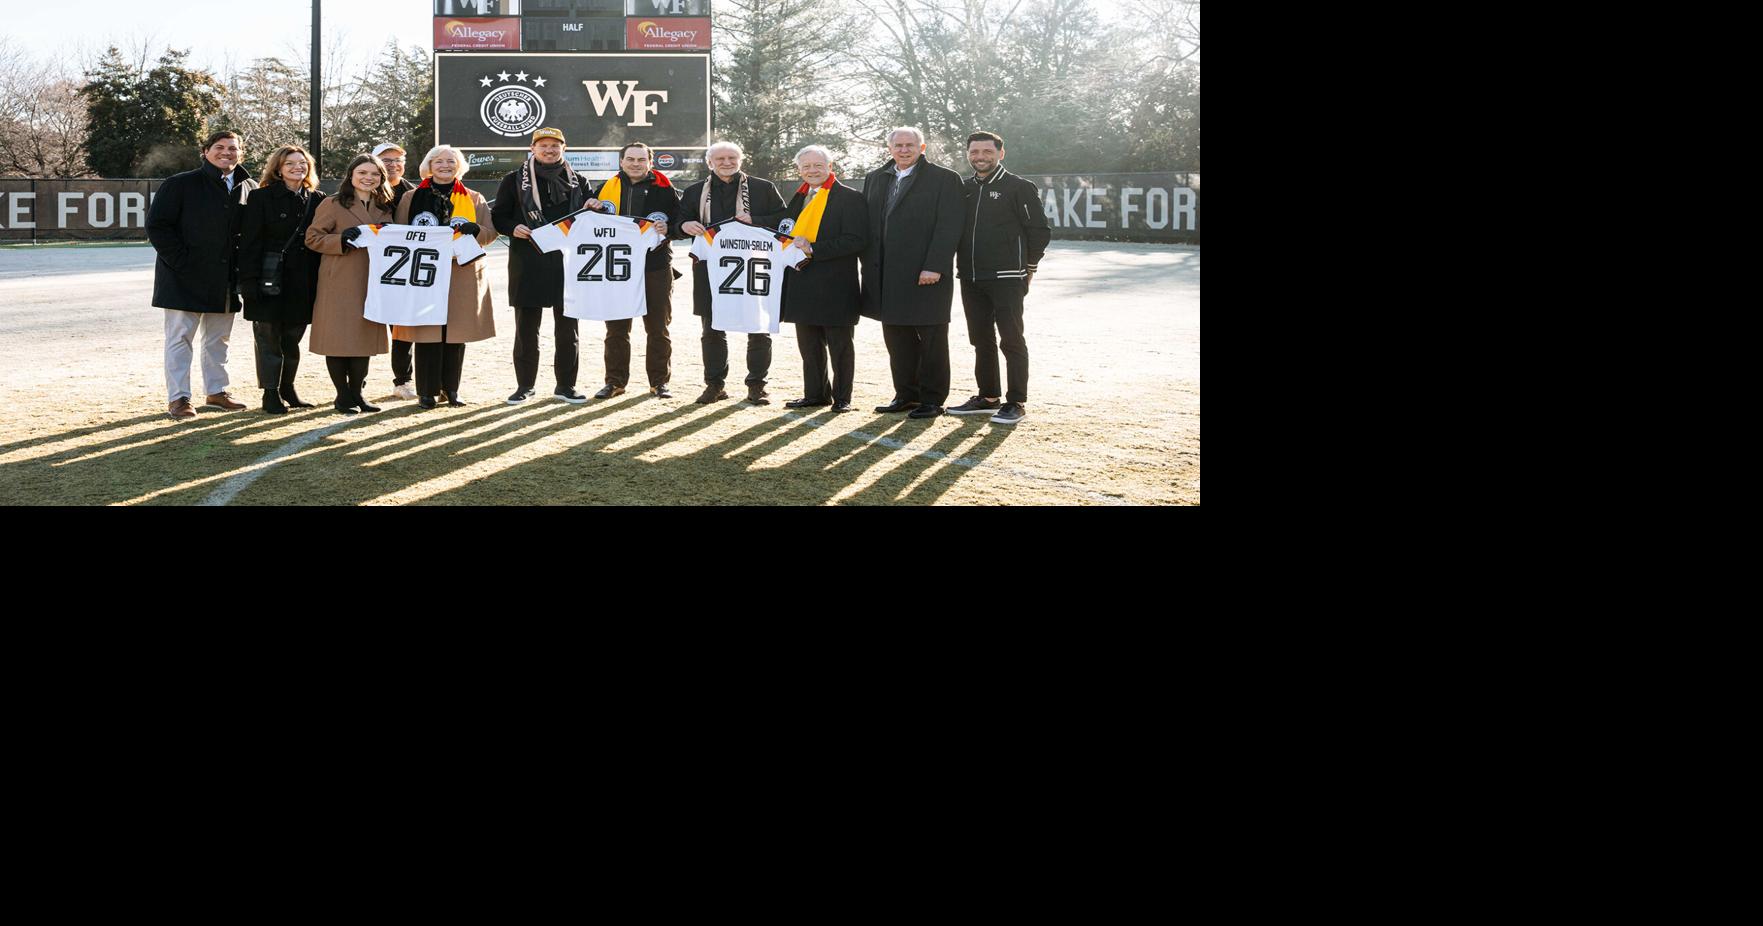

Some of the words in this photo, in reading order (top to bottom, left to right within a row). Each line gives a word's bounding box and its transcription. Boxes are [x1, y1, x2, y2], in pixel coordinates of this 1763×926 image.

[452, 26, 506, 42] Allegacy
[562, 23, 584, 32] HALF
[644, 27, 697, 42] Allegacy
[494, 91, 533, 102] DEUTSCHER
[582, 80, 668, 127] WF
[0, 192, 36, 229] E
[58, 192, 156, 228] FOR
[1038, 188, 1107, 228] AKE
[1121, 187, 1197, 230] FOR
[405, 230, 427, 241] DFB
[594, 227, 616, 238] WFU
[719, 238, 773, 252] WINSTON-SALEM
[380, 245, 440, 287] 26
[577, 243, 632, 282] 26
[718, 255, 772, 297] 26
